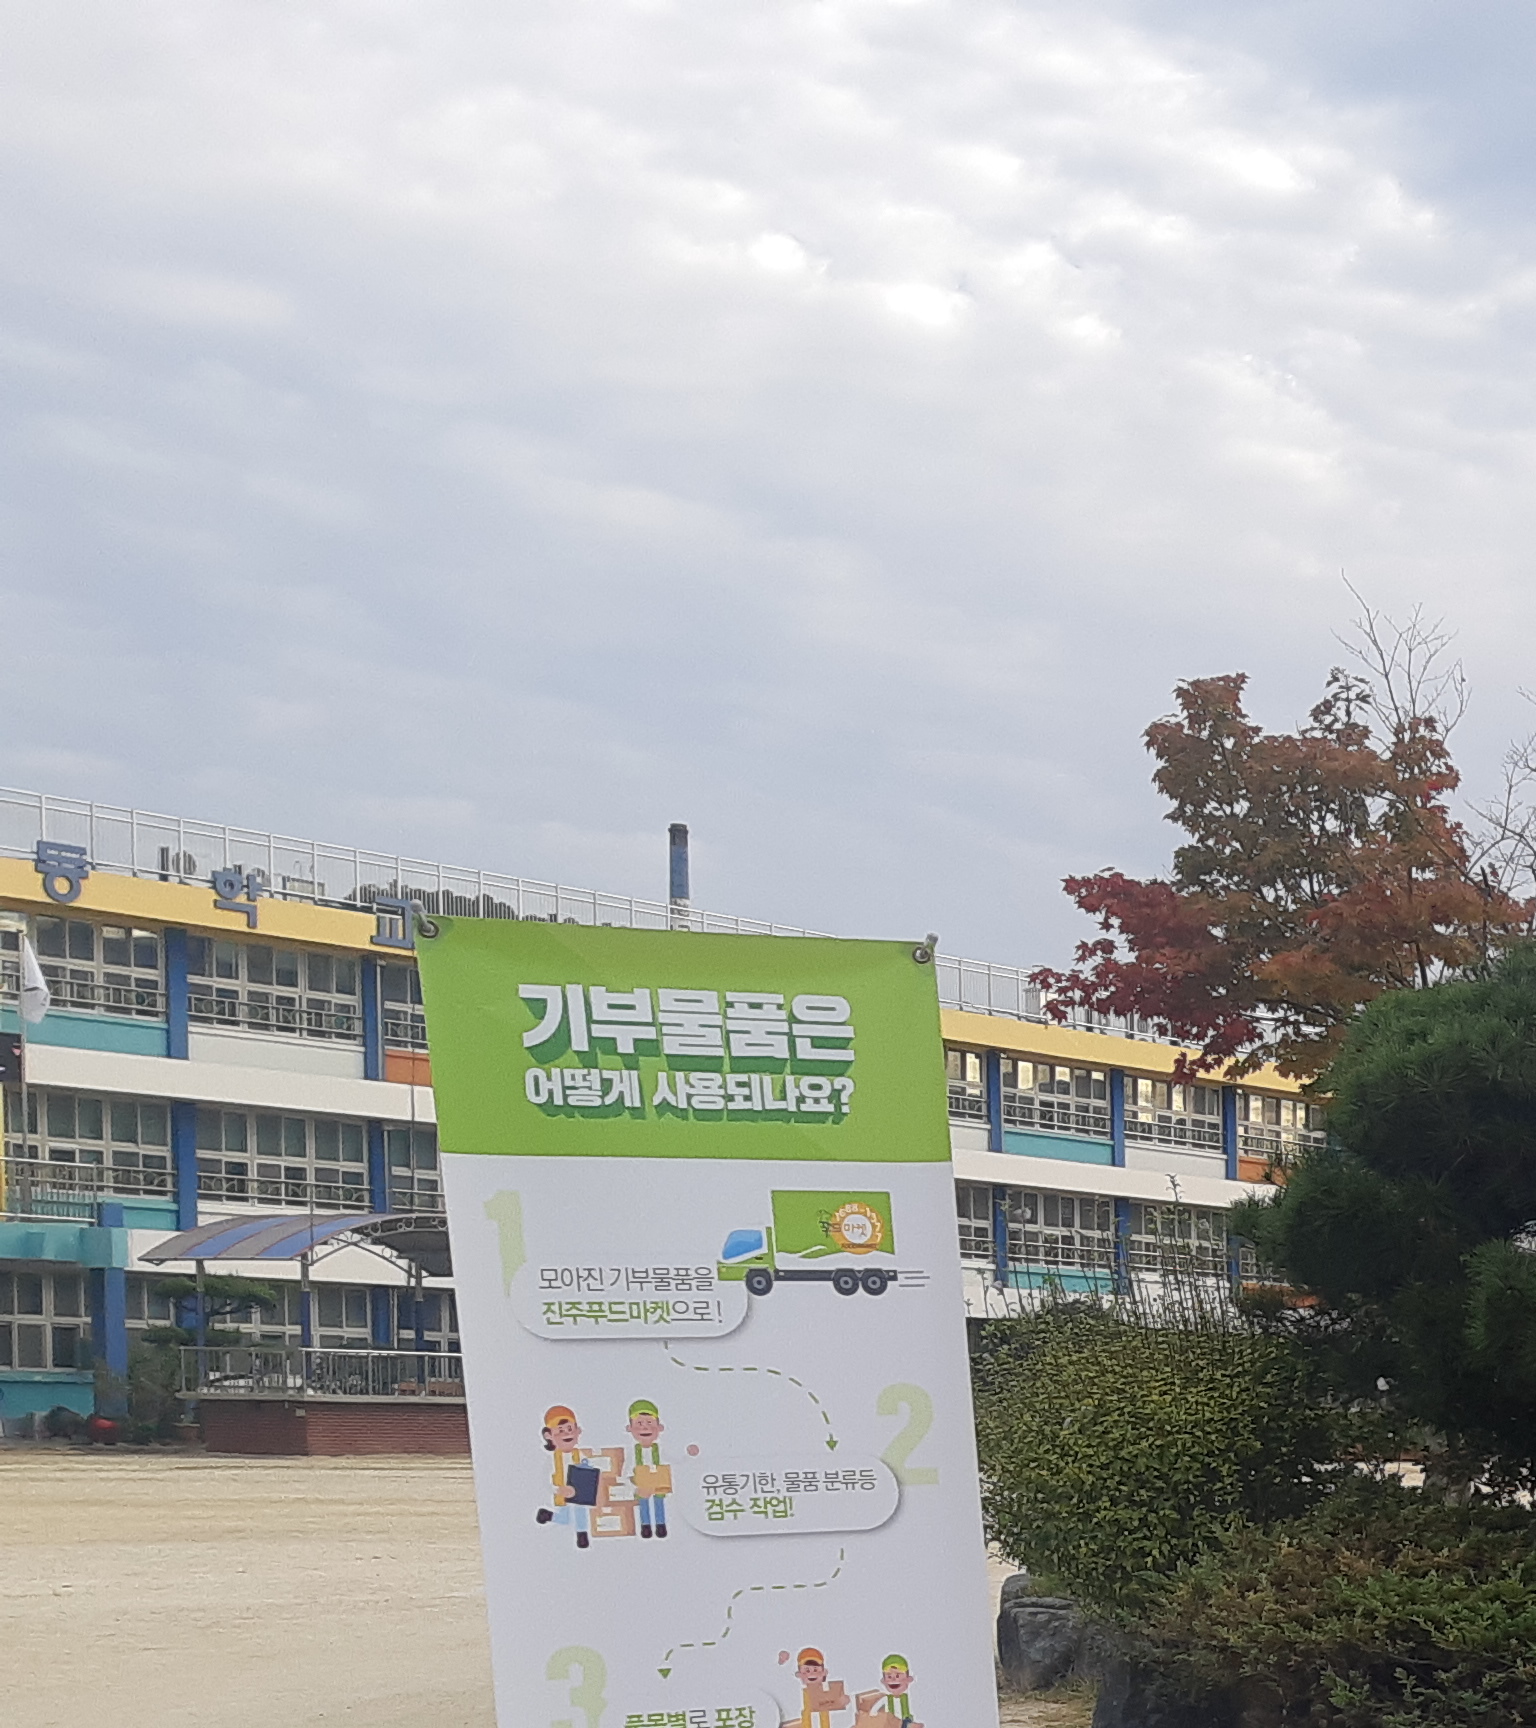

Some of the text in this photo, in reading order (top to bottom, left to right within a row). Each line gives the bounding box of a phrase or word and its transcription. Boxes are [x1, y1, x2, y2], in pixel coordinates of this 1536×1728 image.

[518, 983, 855, 1061] 기부물품은
[525, 1067, 854, 1113] 어떻게 사용되나요?
[539, 1267, 715, 1291] 모아진 기부물품을
[543, 1300, 723, 1325] 진주푸드마켓으로!
[702, 1469, 877, 1495] 유통기한, 물품 분류등
[706, 1497, 794, 1520] 검수 작업!
[715, 1706, 755, 1728] 포장
